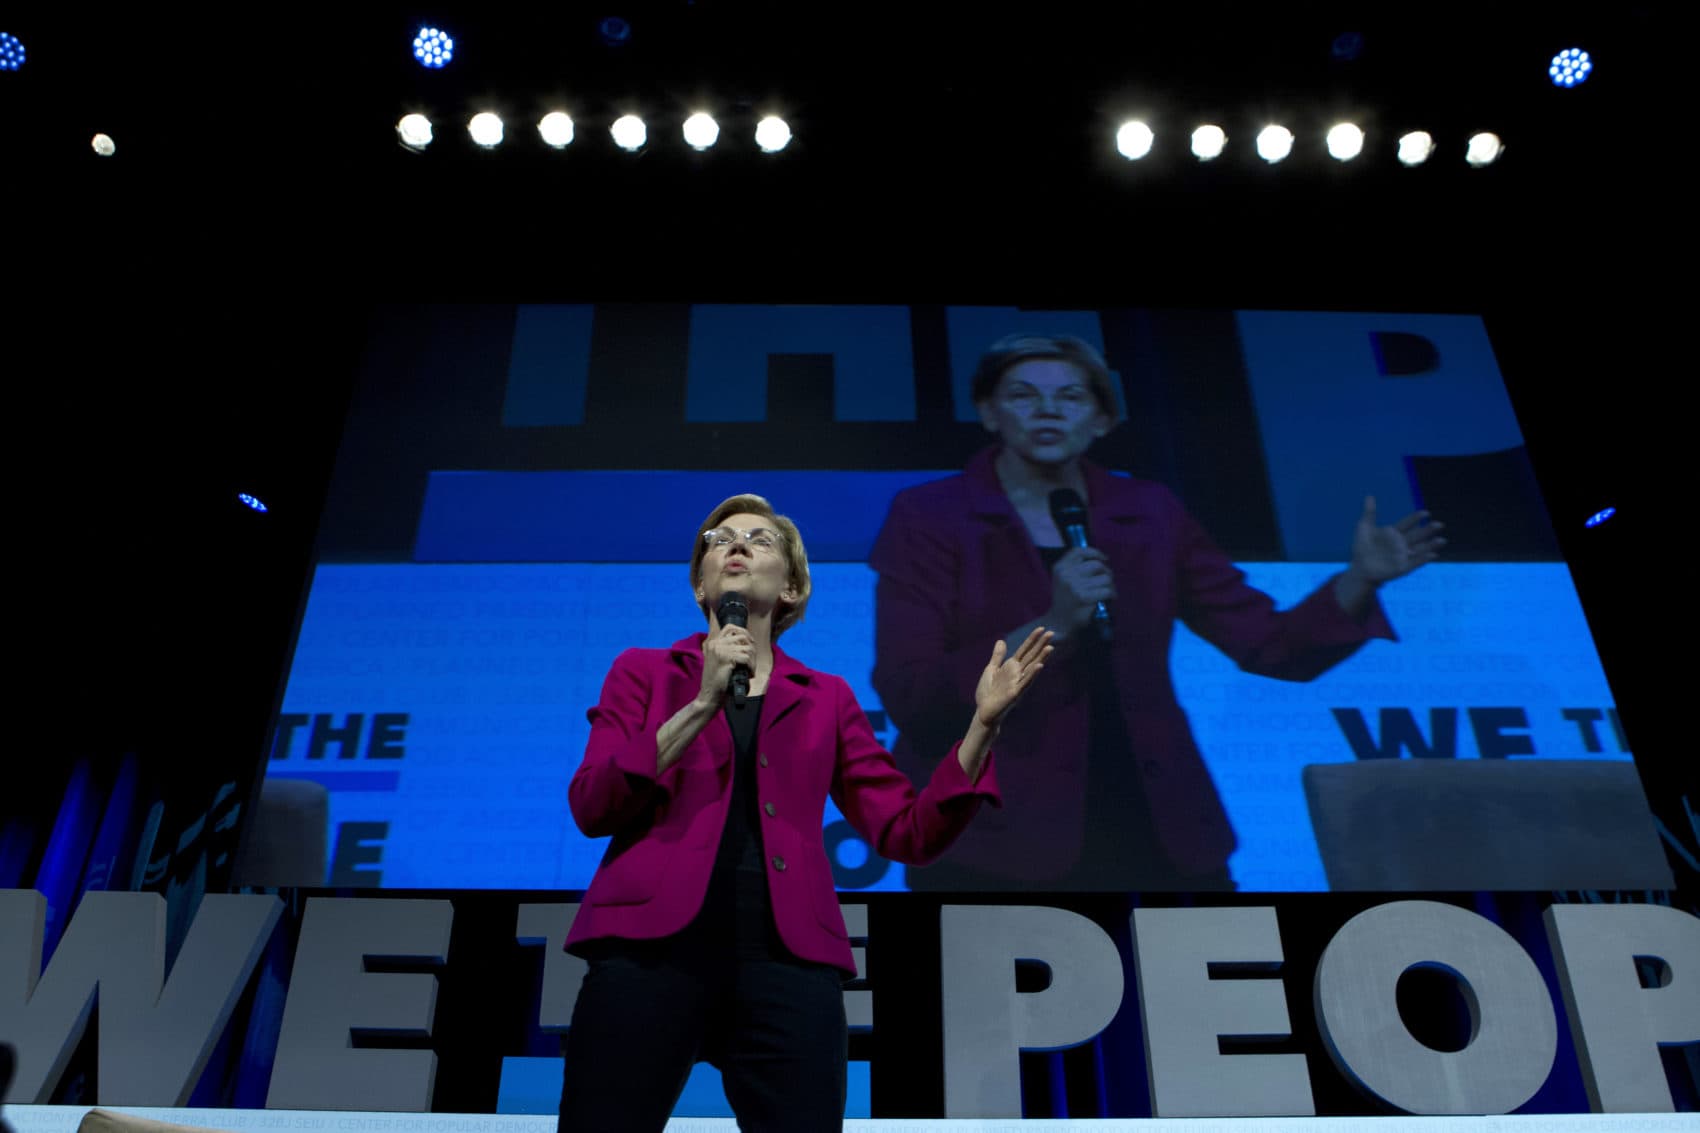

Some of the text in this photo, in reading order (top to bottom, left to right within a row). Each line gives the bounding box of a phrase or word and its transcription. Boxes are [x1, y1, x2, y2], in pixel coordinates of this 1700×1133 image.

[272, 713, 410, 760] THE
[1330, 707, 1535, 760] WE
[0, 889, 454, 1112] WE
[494, 1121, 557, 1133] DEMOCR
